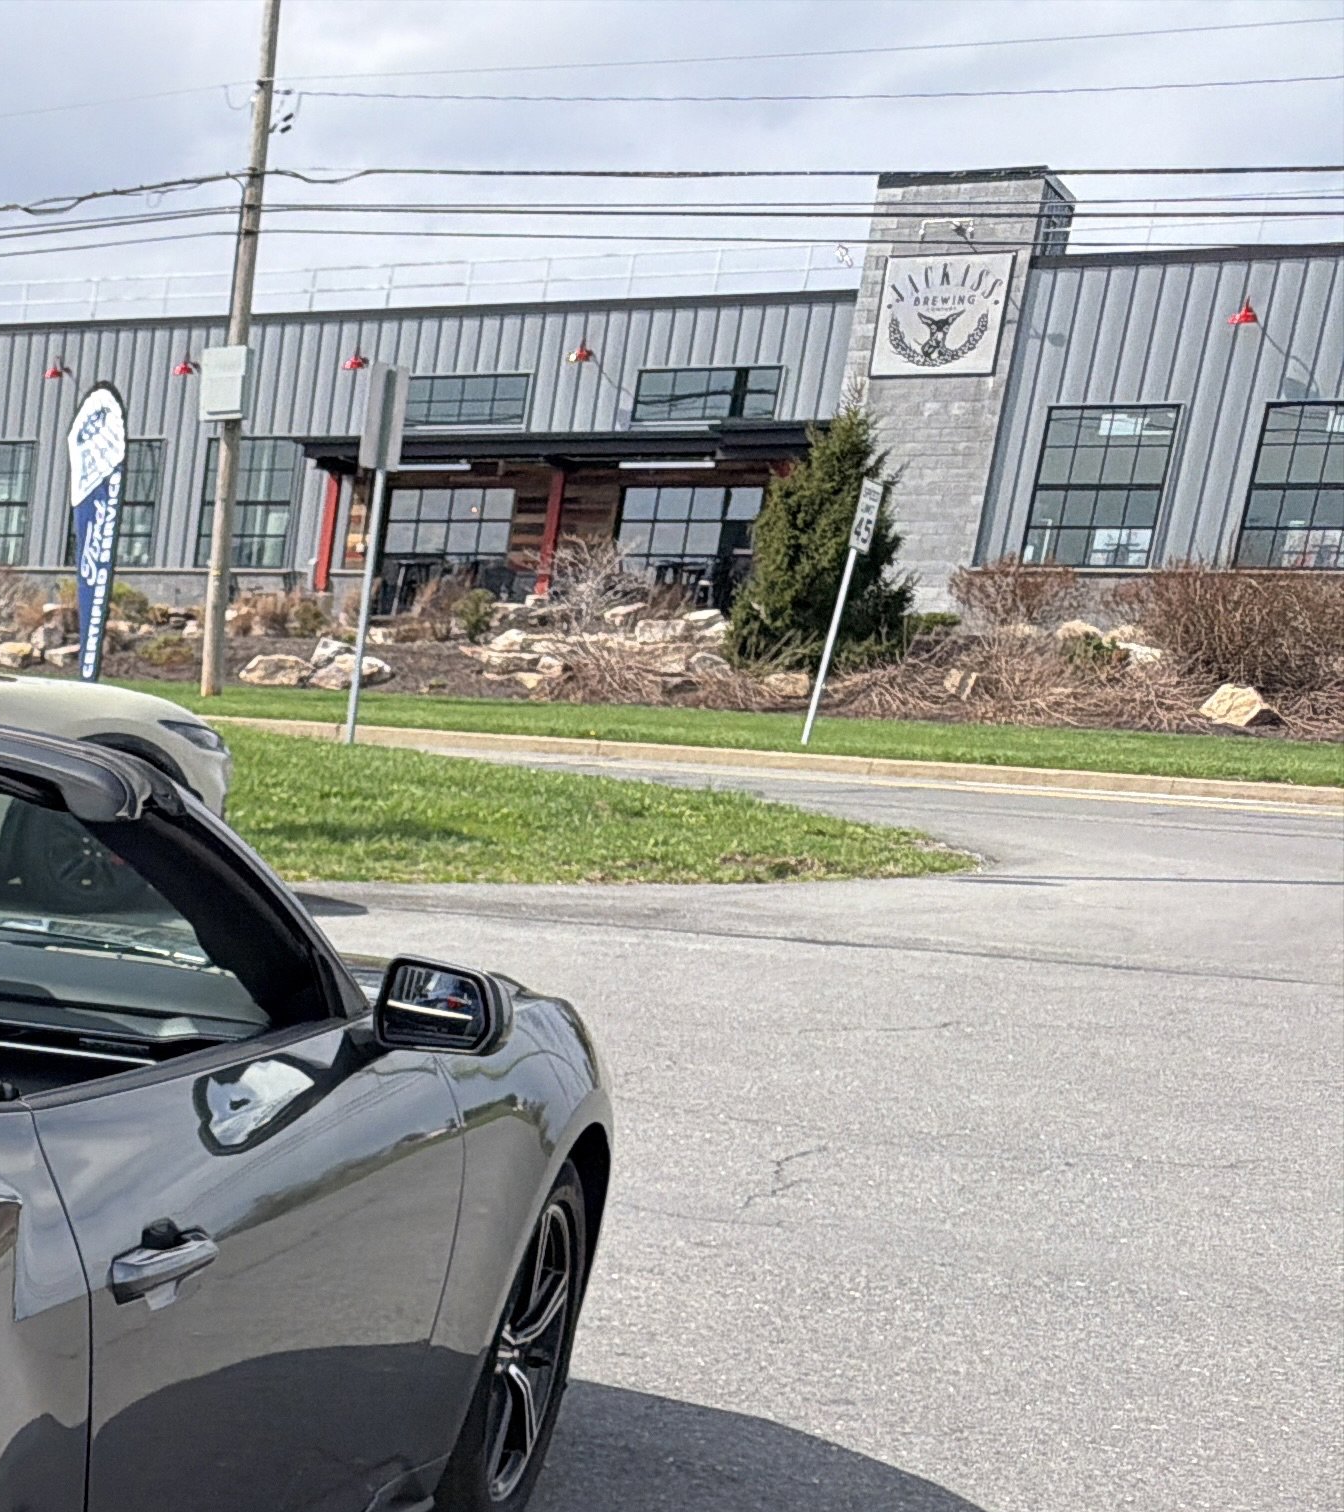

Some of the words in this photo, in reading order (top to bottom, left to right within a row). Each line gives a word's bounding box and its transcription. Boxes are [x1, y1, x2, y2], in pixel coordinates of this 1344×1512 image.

[913, 294, 976, 307] BREWING
[81, 499, 106, 586] Ford
[853, 516, 873, 545] 45
[82, 567, 108, 679] CERTIFIED
